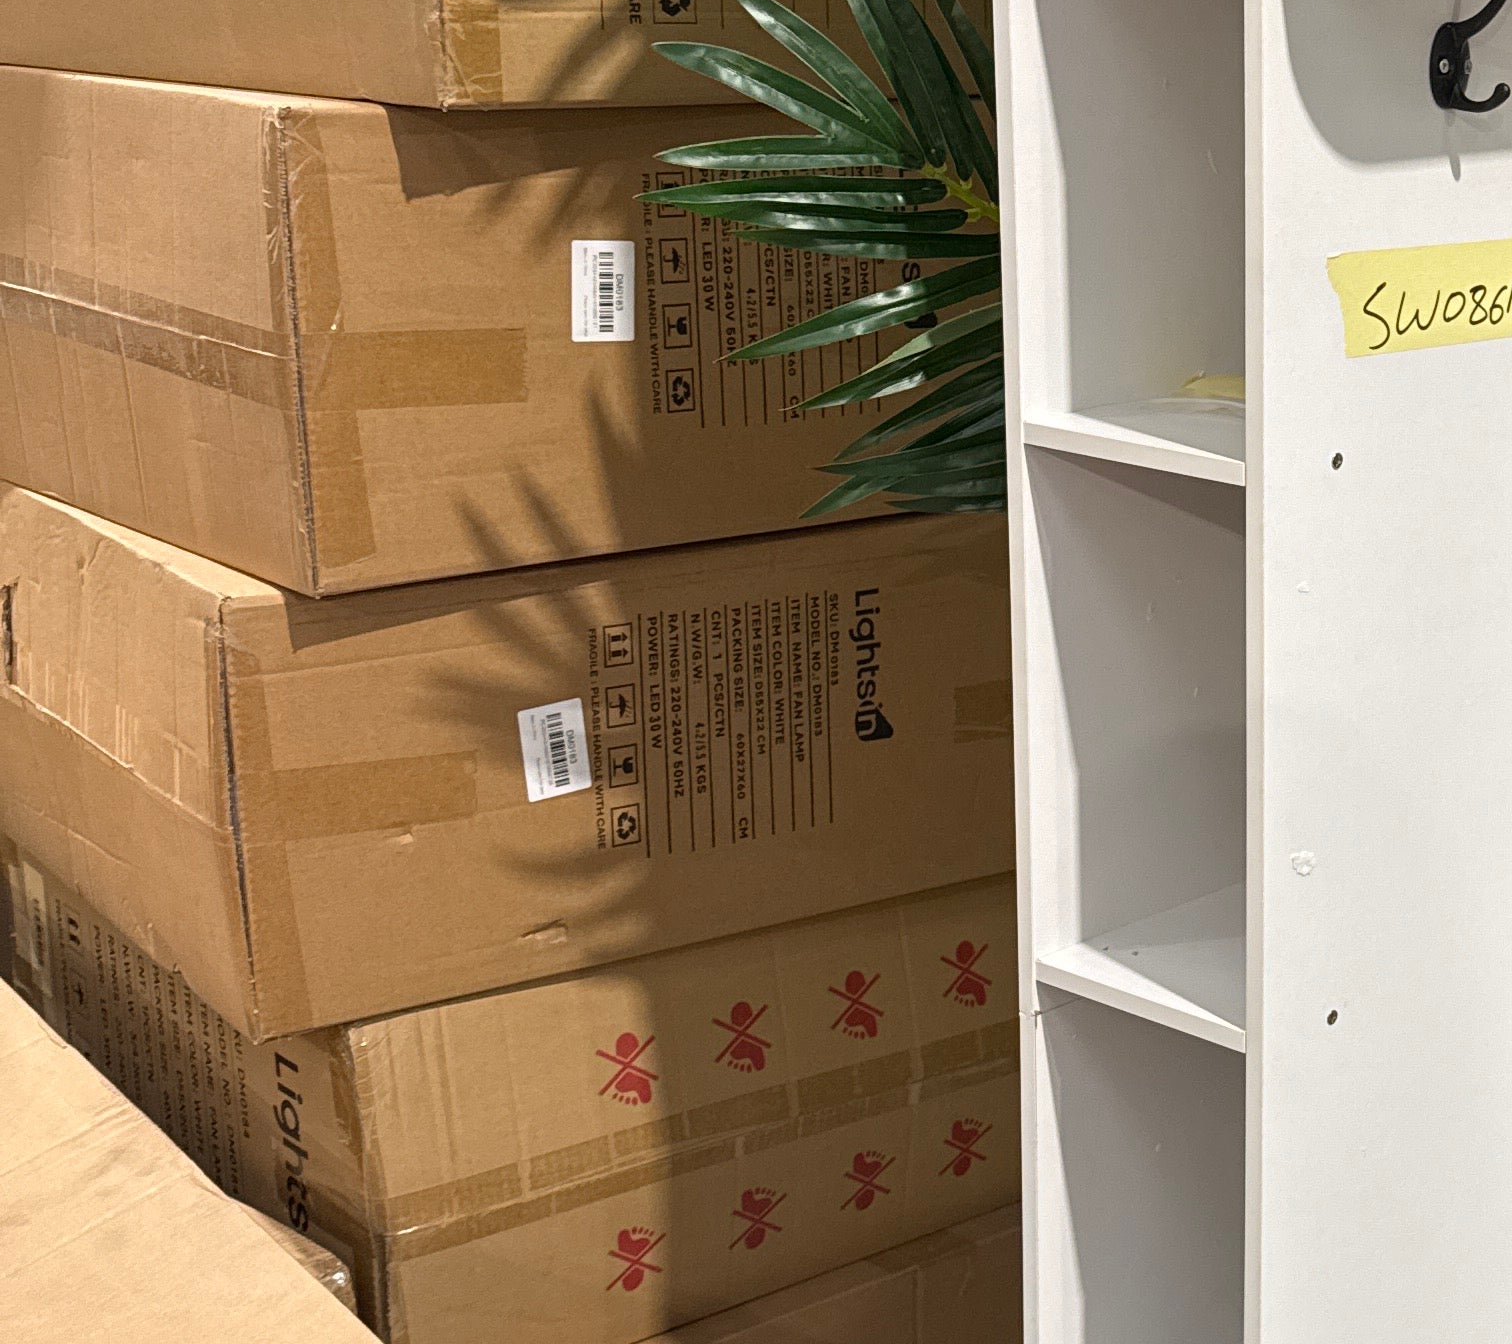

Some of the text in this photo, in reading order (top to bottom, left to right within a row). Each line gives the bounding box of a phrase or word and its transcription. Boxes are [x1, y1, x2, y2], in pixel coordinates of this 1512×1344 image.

[647, 288, 658, 341] HANDLE
[650, 344, 661, 377] WITH
[652, 380, 662, 414] CARE
[751, 605, 762, 640] ITEM
[810, 596, 821, 647] MODEL
[829, 593, 839, 627] SKU:
[711, 611, 722, 645] CNT:
[731, 608, 743, 673] PACKING
[647, 616, 659, 676] POWER:
[753, 644, 764, 679] SIZE:
[771, 602, 785, 745] ITEM COLOR: WHITE
[791, 599, 805, 762] ITEM NAME: FAN LAMP
[649, 684, 660, 712] LED
[668, 614, 684, 798] RATINGS: 220-240V 50HZ
[713, 673, 725, 738] PCS/CTN
[734, 677, 744, 712] SIZE:
[588, 628, 606, 849] FRAGILE PLEASE HANDLE WITH CARE
[696, 765, 707, 794] KGS
[738, 817, 749, 839] CM
